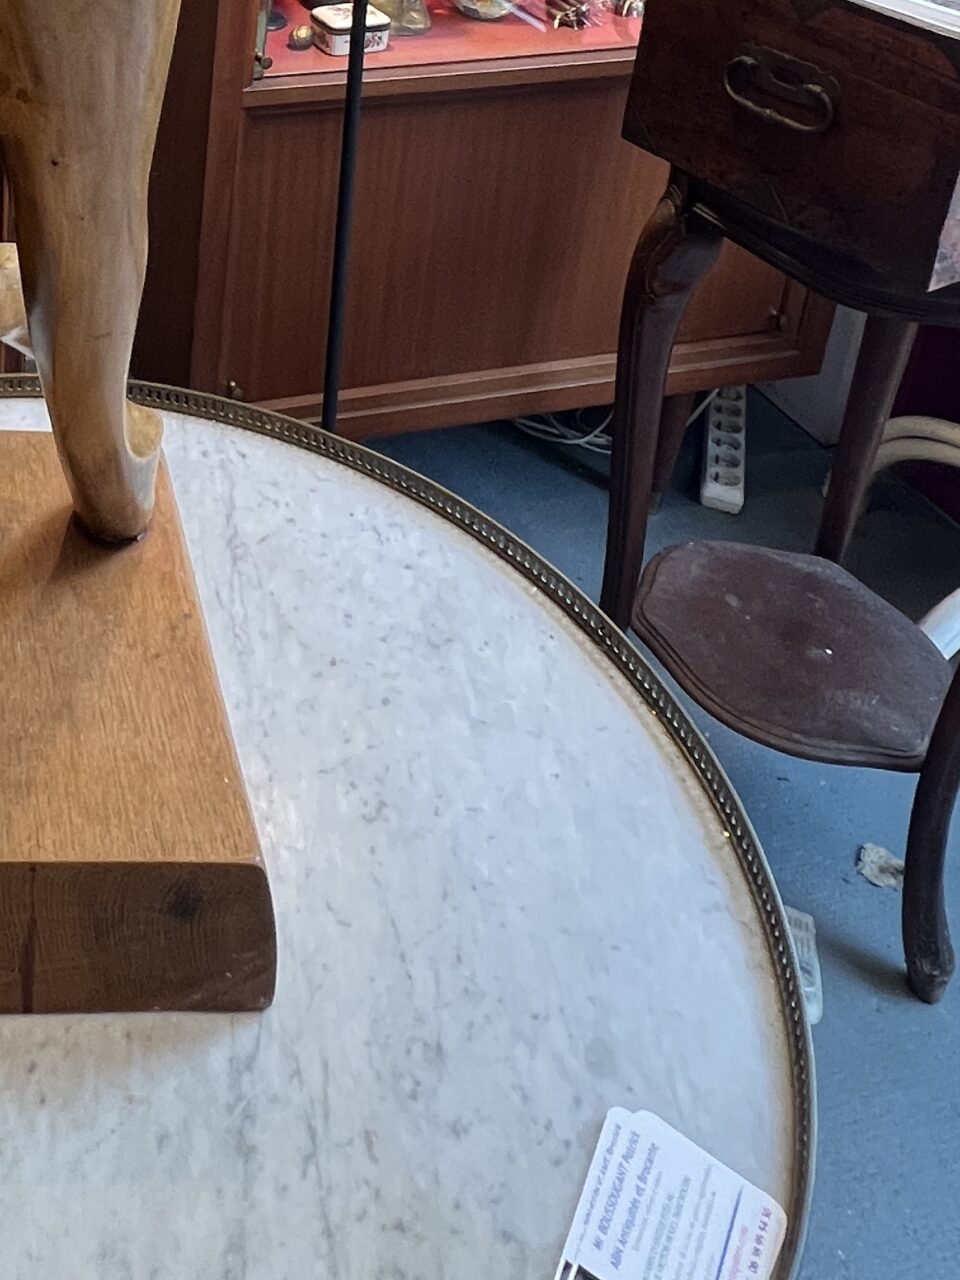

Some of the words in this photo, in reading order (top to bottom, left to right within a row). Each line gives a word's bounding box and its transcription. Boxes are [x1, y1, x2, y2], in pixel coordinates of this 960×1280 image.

[622, 1131, 640, 1165] Patrick
[637, 1142, 660, 1185] Brocante
[635, 1183, 646, 1197] et
